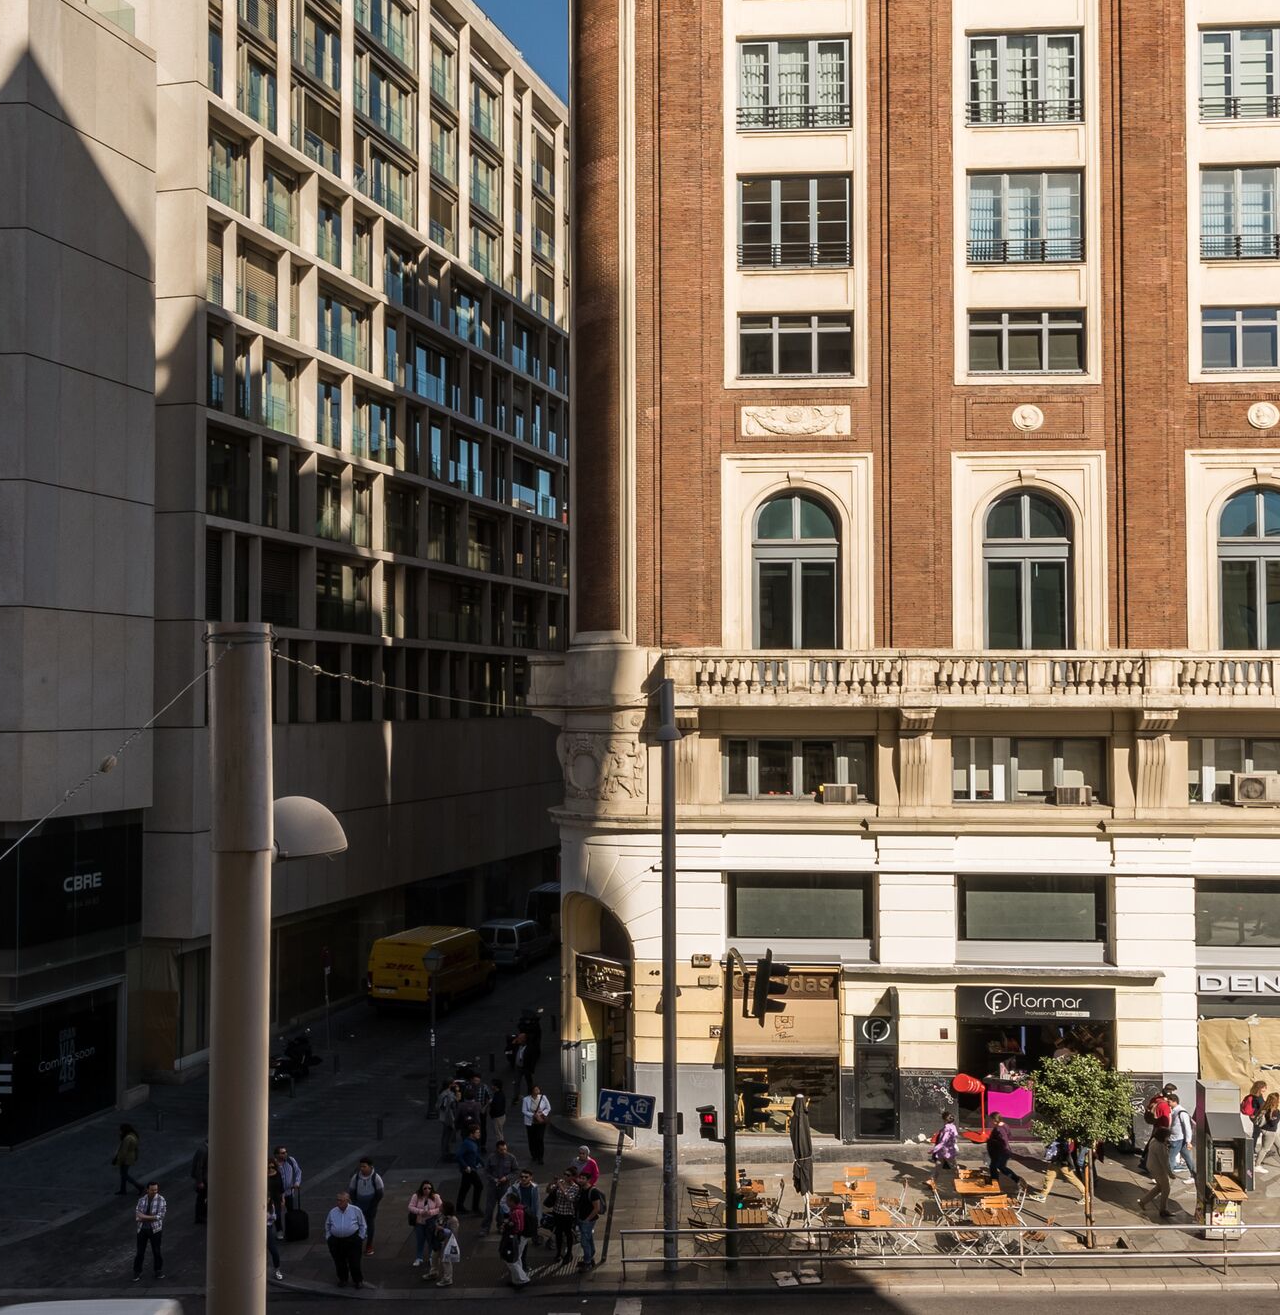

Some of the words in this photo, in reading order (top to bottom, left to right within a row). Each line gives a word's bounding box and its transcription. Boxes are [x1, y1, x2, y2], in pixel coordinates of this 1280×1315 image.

[63, 871, 103, 892] CBRE
[385, 962, 416, 972] DHL
[1013, 992, 1083, 1009] flormar
[38, 1054, 73, 1072] Coming
[74, 1046, 96, 1062] soon
